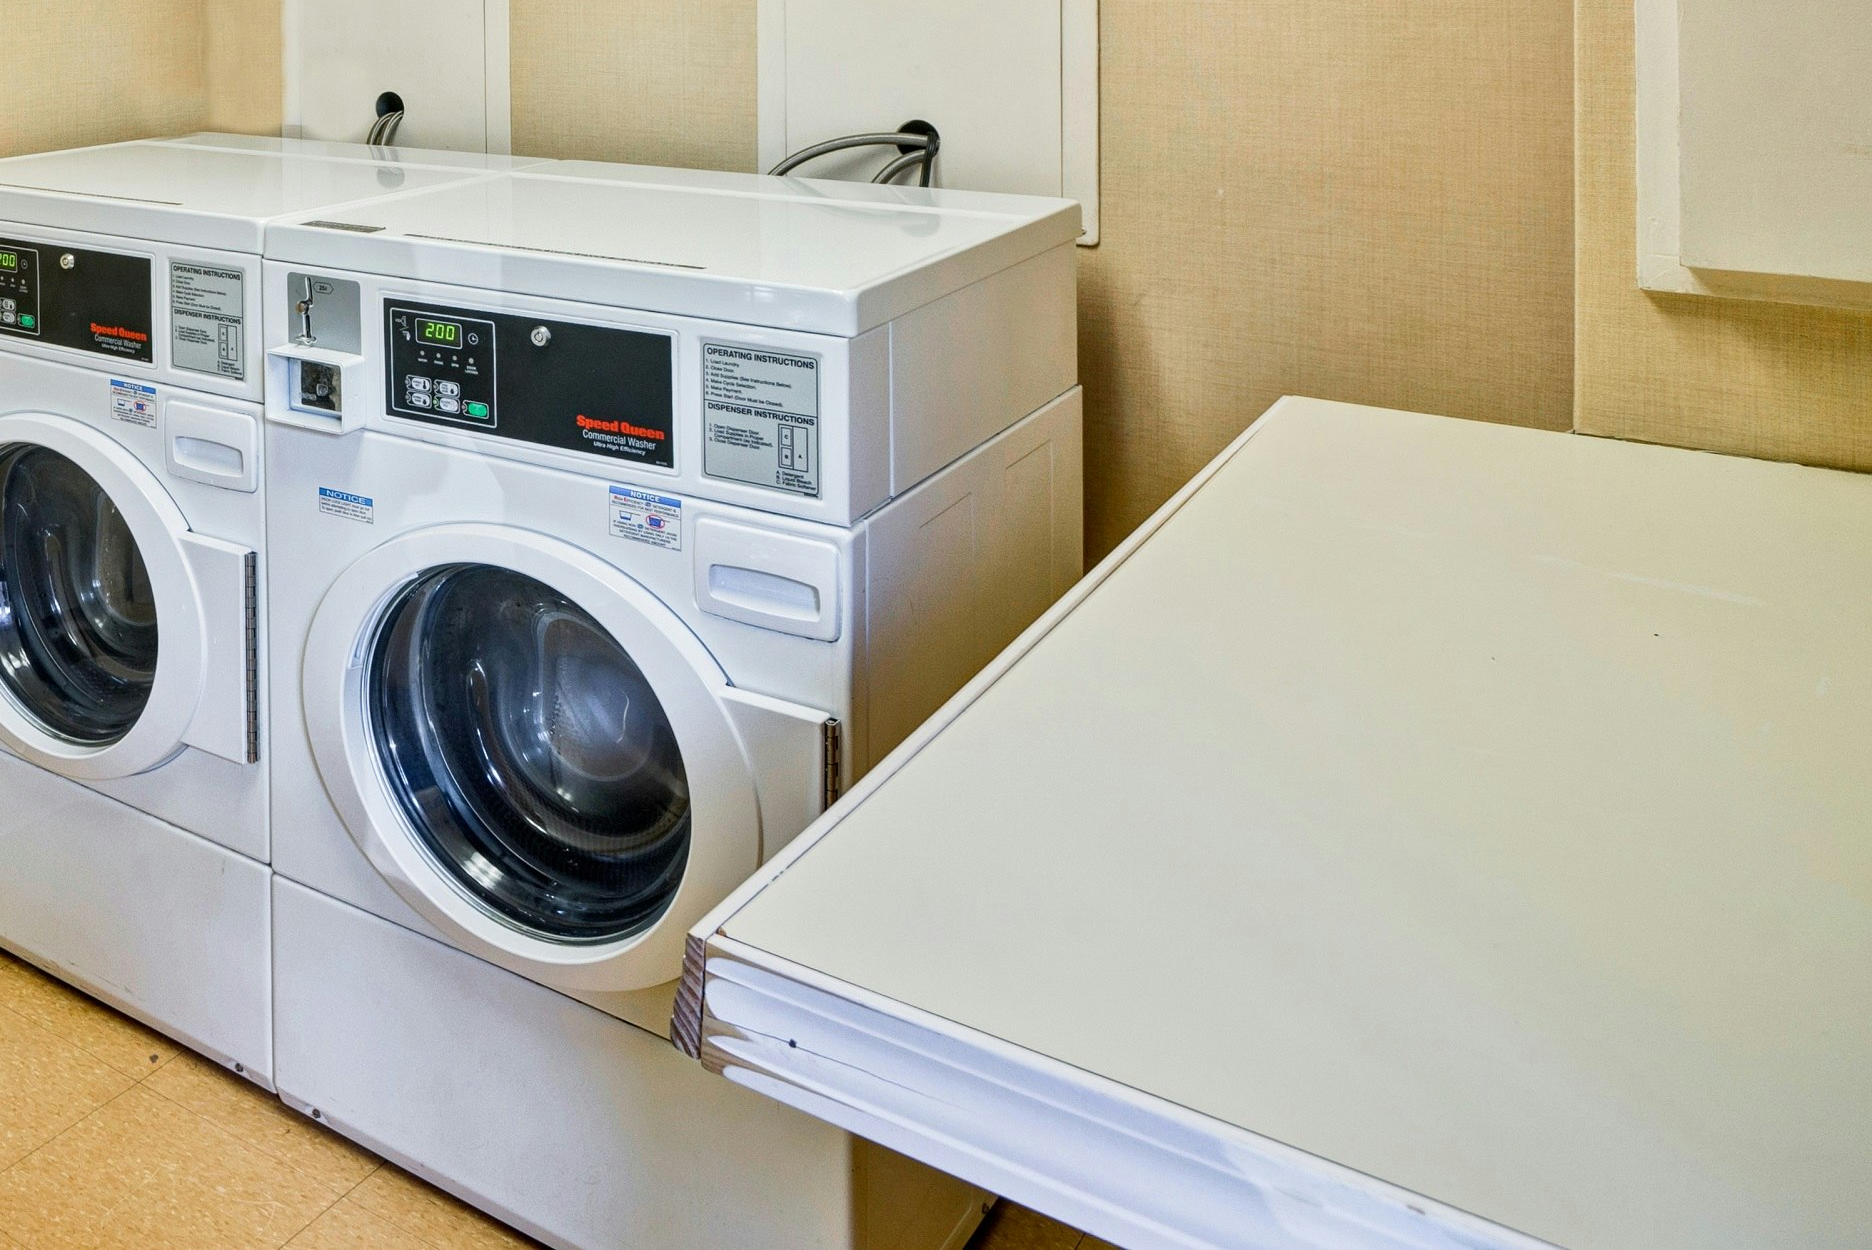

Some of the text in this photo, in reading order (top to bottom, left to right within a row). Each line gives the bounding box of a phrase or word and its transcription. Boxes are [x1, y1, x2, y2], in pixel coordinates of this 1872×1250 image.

[173, 265, 241, 280] OPERATING INSTRUCTIONS
[174, 309, 241, 324] DISPENSER INSTRUCTIONS
[90, 322, 147, 341] Speed Queen
[426, 323, 454, 340] 200
[95, 334, 141, 349] Commercial Washer
[707, 348, 814, 369] OPERATING INSTRUCTIONS
[708, 403, 814, 425] DISPENSER INSTRUCTIONS
[576, 415, 664, 440] Speed Queen
[583, 429, 656, 450] Commercial Washer
[620, 446, 646, 456] Efficiency
[327, 490, 366, 504] NOTICE
[631, 491, 659, 502] NOTICE
